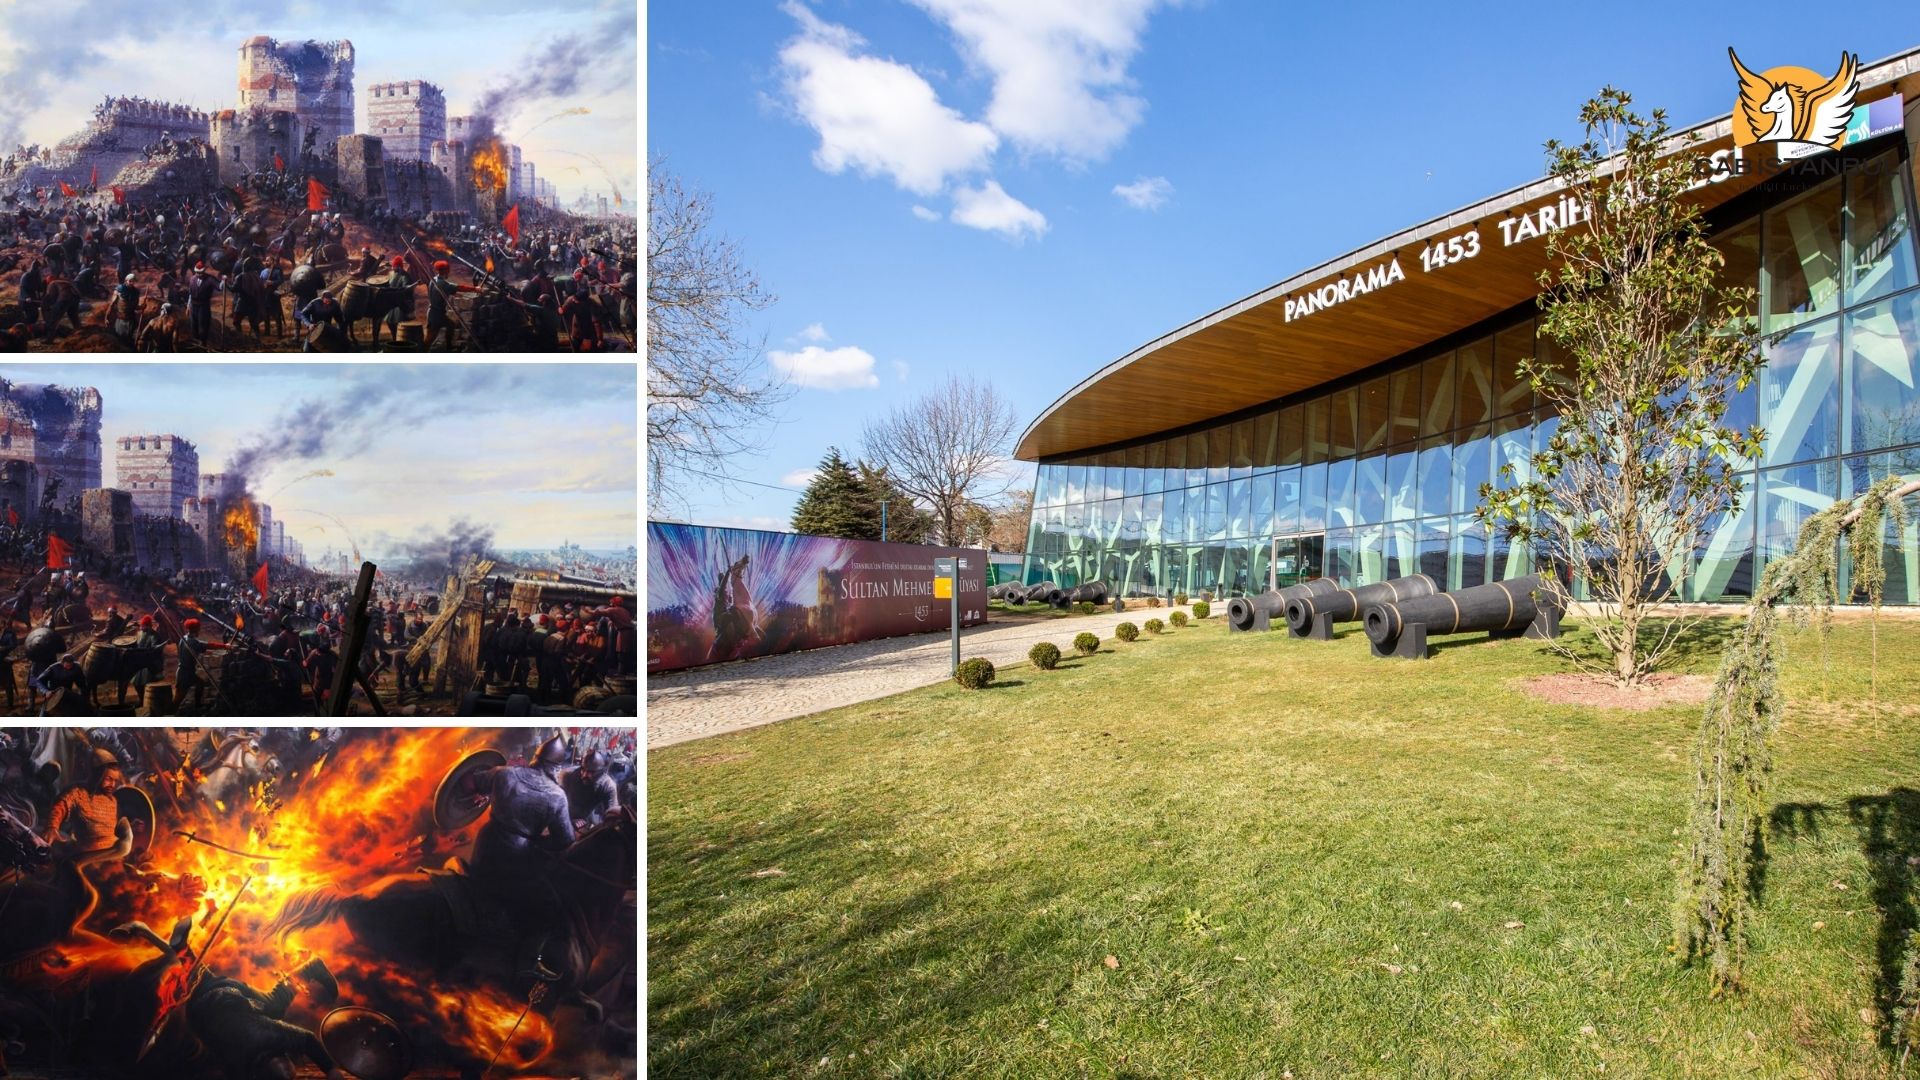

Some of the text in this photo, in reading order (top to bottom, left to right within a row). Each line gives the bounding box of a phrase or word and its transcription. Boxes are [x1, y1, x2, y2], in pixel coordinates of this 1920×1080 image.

[1284, 194, 1592, 323] PANORAMA 1453 TARİH
[841, 576, 979, 600] SULTAN MEHME ÜYASI
[914, 605, 929, 621] 1453
